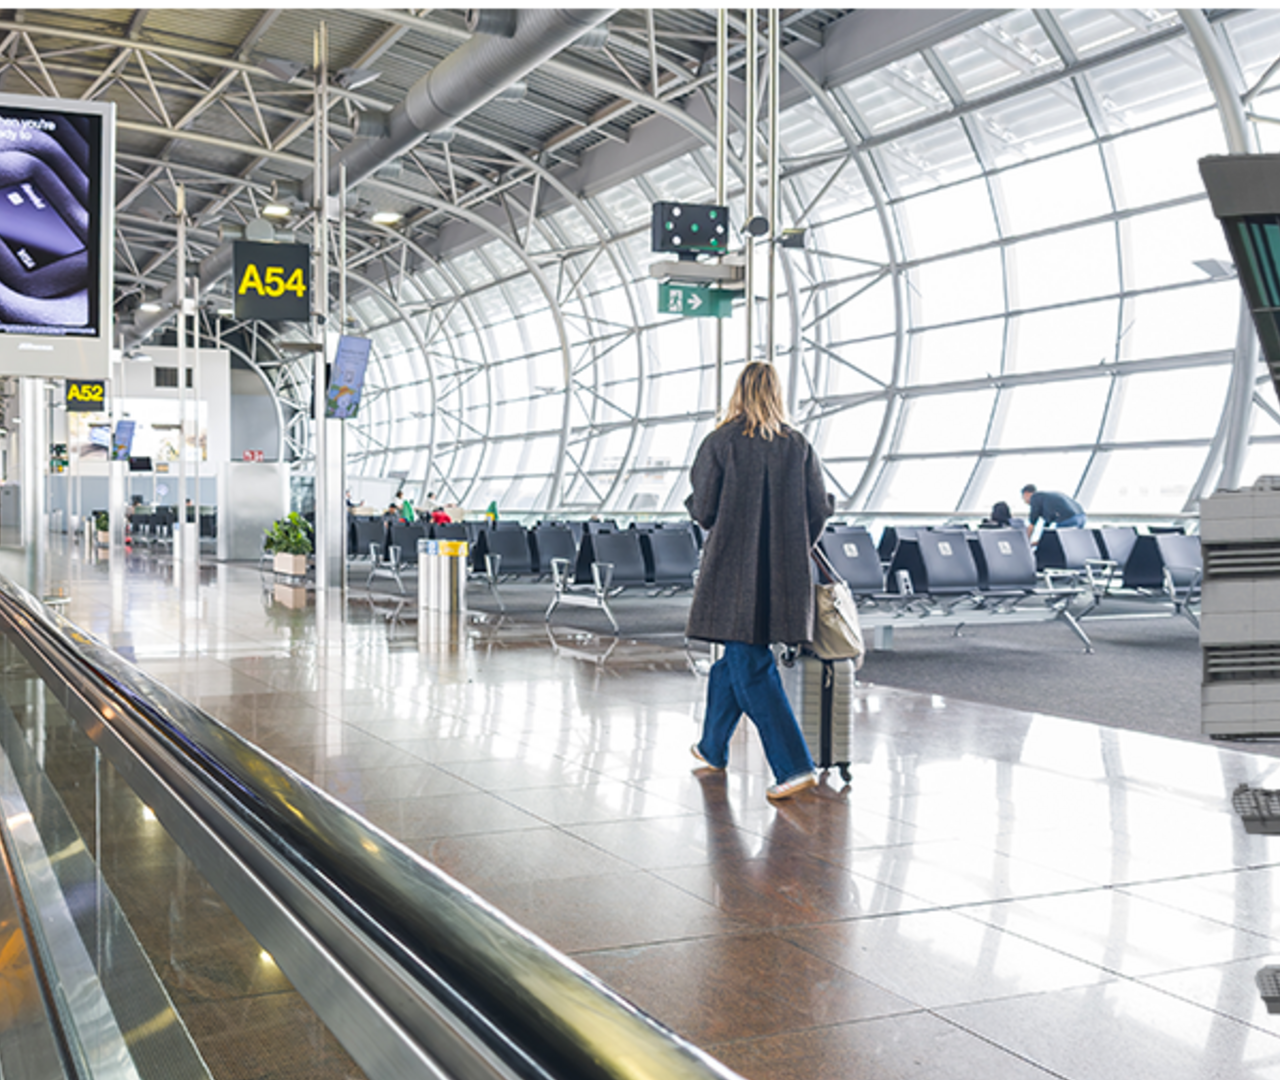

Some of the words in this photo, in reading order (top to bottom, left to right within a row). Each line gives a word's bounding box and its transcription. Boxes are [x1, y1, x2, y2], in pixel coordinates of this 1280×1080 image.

[21, 118, 57, 131] you're
[19, 130, 32, 141] to
[238, 263, 306, 297] A54
[68, 385, 104, 402] A52
